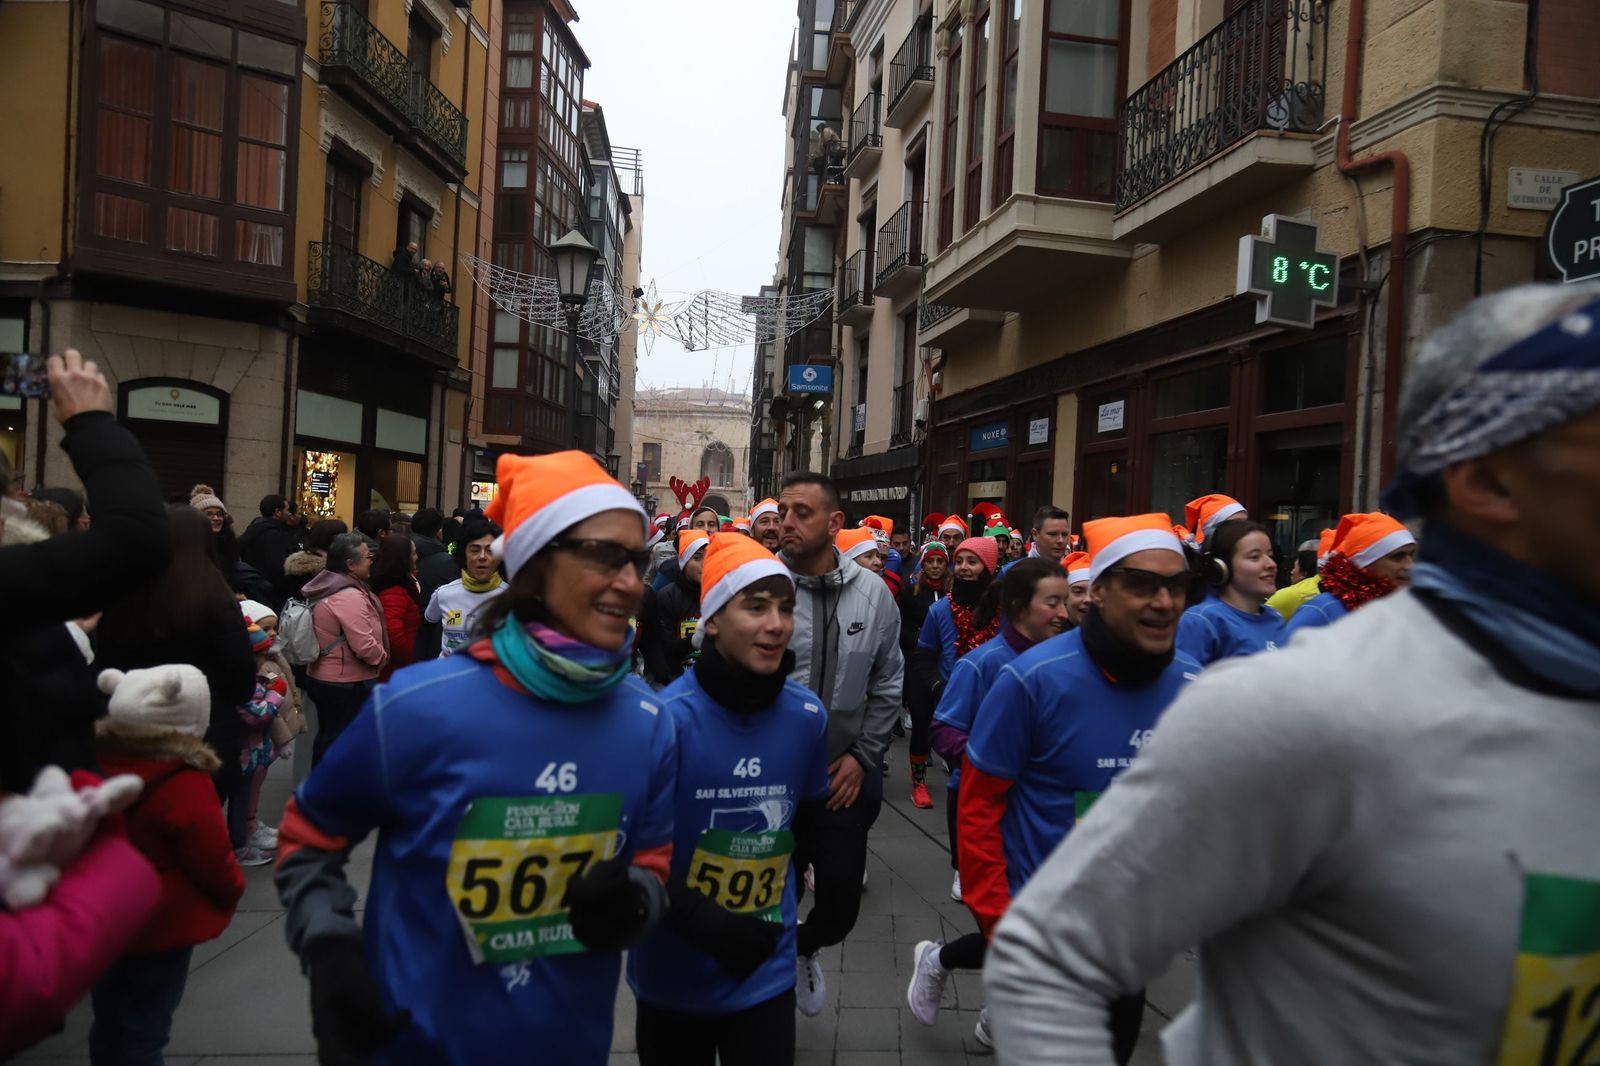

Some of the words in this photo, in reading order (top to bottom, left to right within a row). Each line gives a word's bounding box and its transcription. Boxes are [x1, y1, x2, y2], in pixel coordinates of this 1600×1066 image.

[1534, 175, 1564, 184] CALLE
[1539, 186, 1552, 194] DE
[1272, 256, 1288, 283] 8
[791, 384, 828, 392] Samsonite
[982, 429, 1000, 440] NUXE
[733, 757, 762, 778] 46
[1096, 758, 1116, 768] SAN
[534, 762, 578, 793] 46
[695, 788, 715, 799] SAN
[717, 786, 767, 799] SILVESTRE
[459, 851, 594, 919] 567
[697, 862, 776, 909] 593
[490, 930, 535, 950] CAJA
